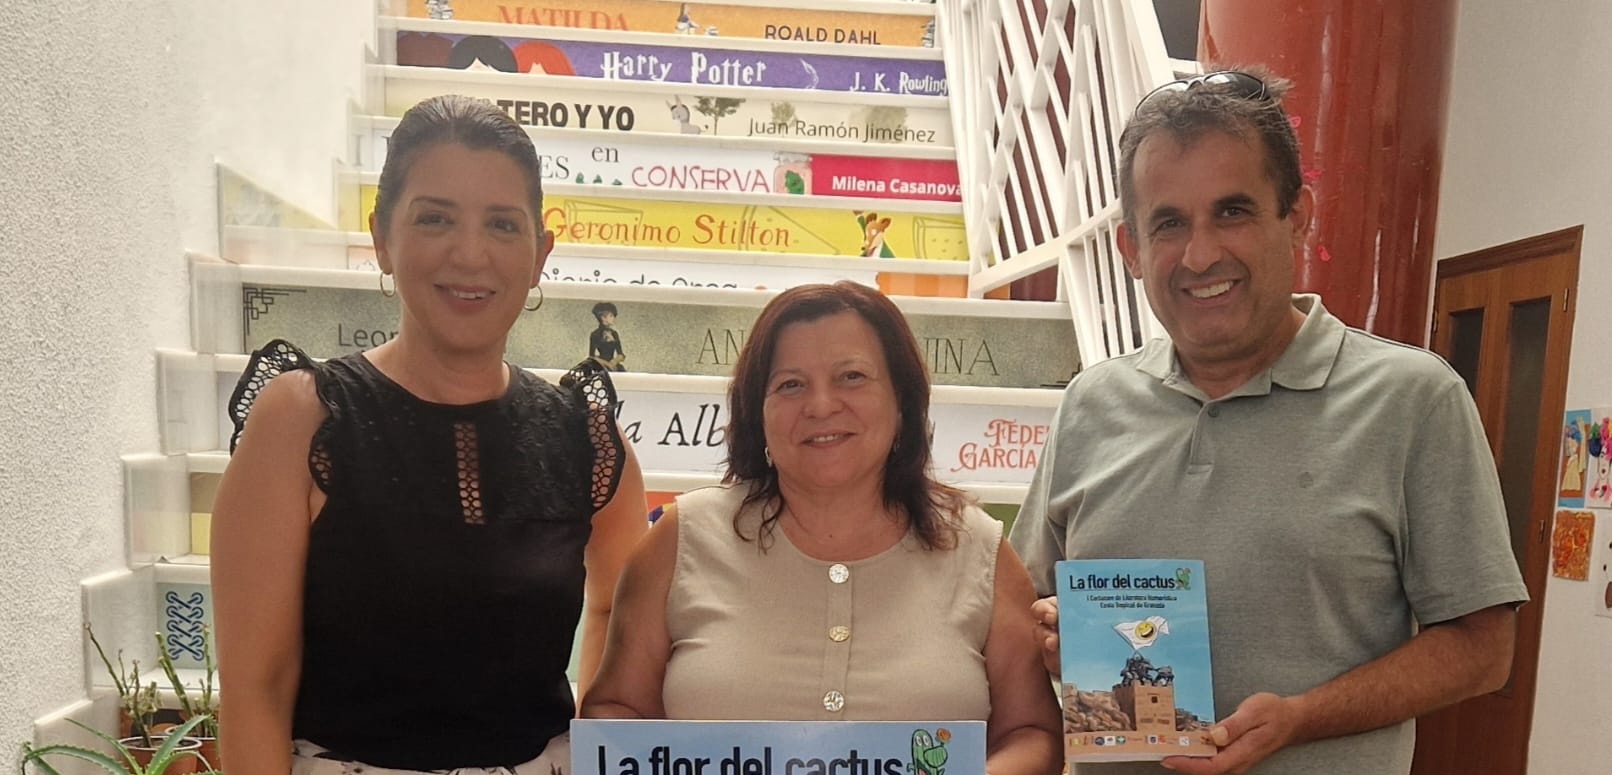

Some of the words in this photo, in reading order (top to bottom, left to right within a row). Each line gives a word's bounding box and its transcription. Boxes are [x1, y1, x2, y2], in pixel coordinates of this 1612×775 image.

[498, 6, 628, 31] MATILDA
[764, 25, 828, 43] ROALD
[834, 28, 882, 45] DAHL
[601, 51, 673, 82] Harry
[691, 52, 767, 87] Potter
[850, 72, 866, 92] J.
[875, 73, 891, 92] K.
[899, 72, 948, 96] Rowling
[497, 99, 569, 128] TERO
[575, 104, 593, 129] Y
[598, 105, 635, 131] YO
[748, 118, 790, 137] Juan
[795, 120, 860, 140] Ramón
[863, 123, 936, 143] Jiménez
[591, 146, 619, 163] en
[632, 165, 771, 193] CONSERVA
[832, 176, 886, 193] Milena
[889, 179, 962, 197] Casanova
[544, 207, 681, 245] Geronimo
[692, 213, 790, 247] Stilton
[1069, 575, 1085, 590] La
[1088, 574, 1109, 589] flor
[1112, 574, 1131, 589] del
[1134, 575, 1176, 589] cactus
[598, 746, 640, 775] La
[648, 746, 710, 775] flor
[720, 746, 772, 775] del
[784, 749, 903, 775] cactus
